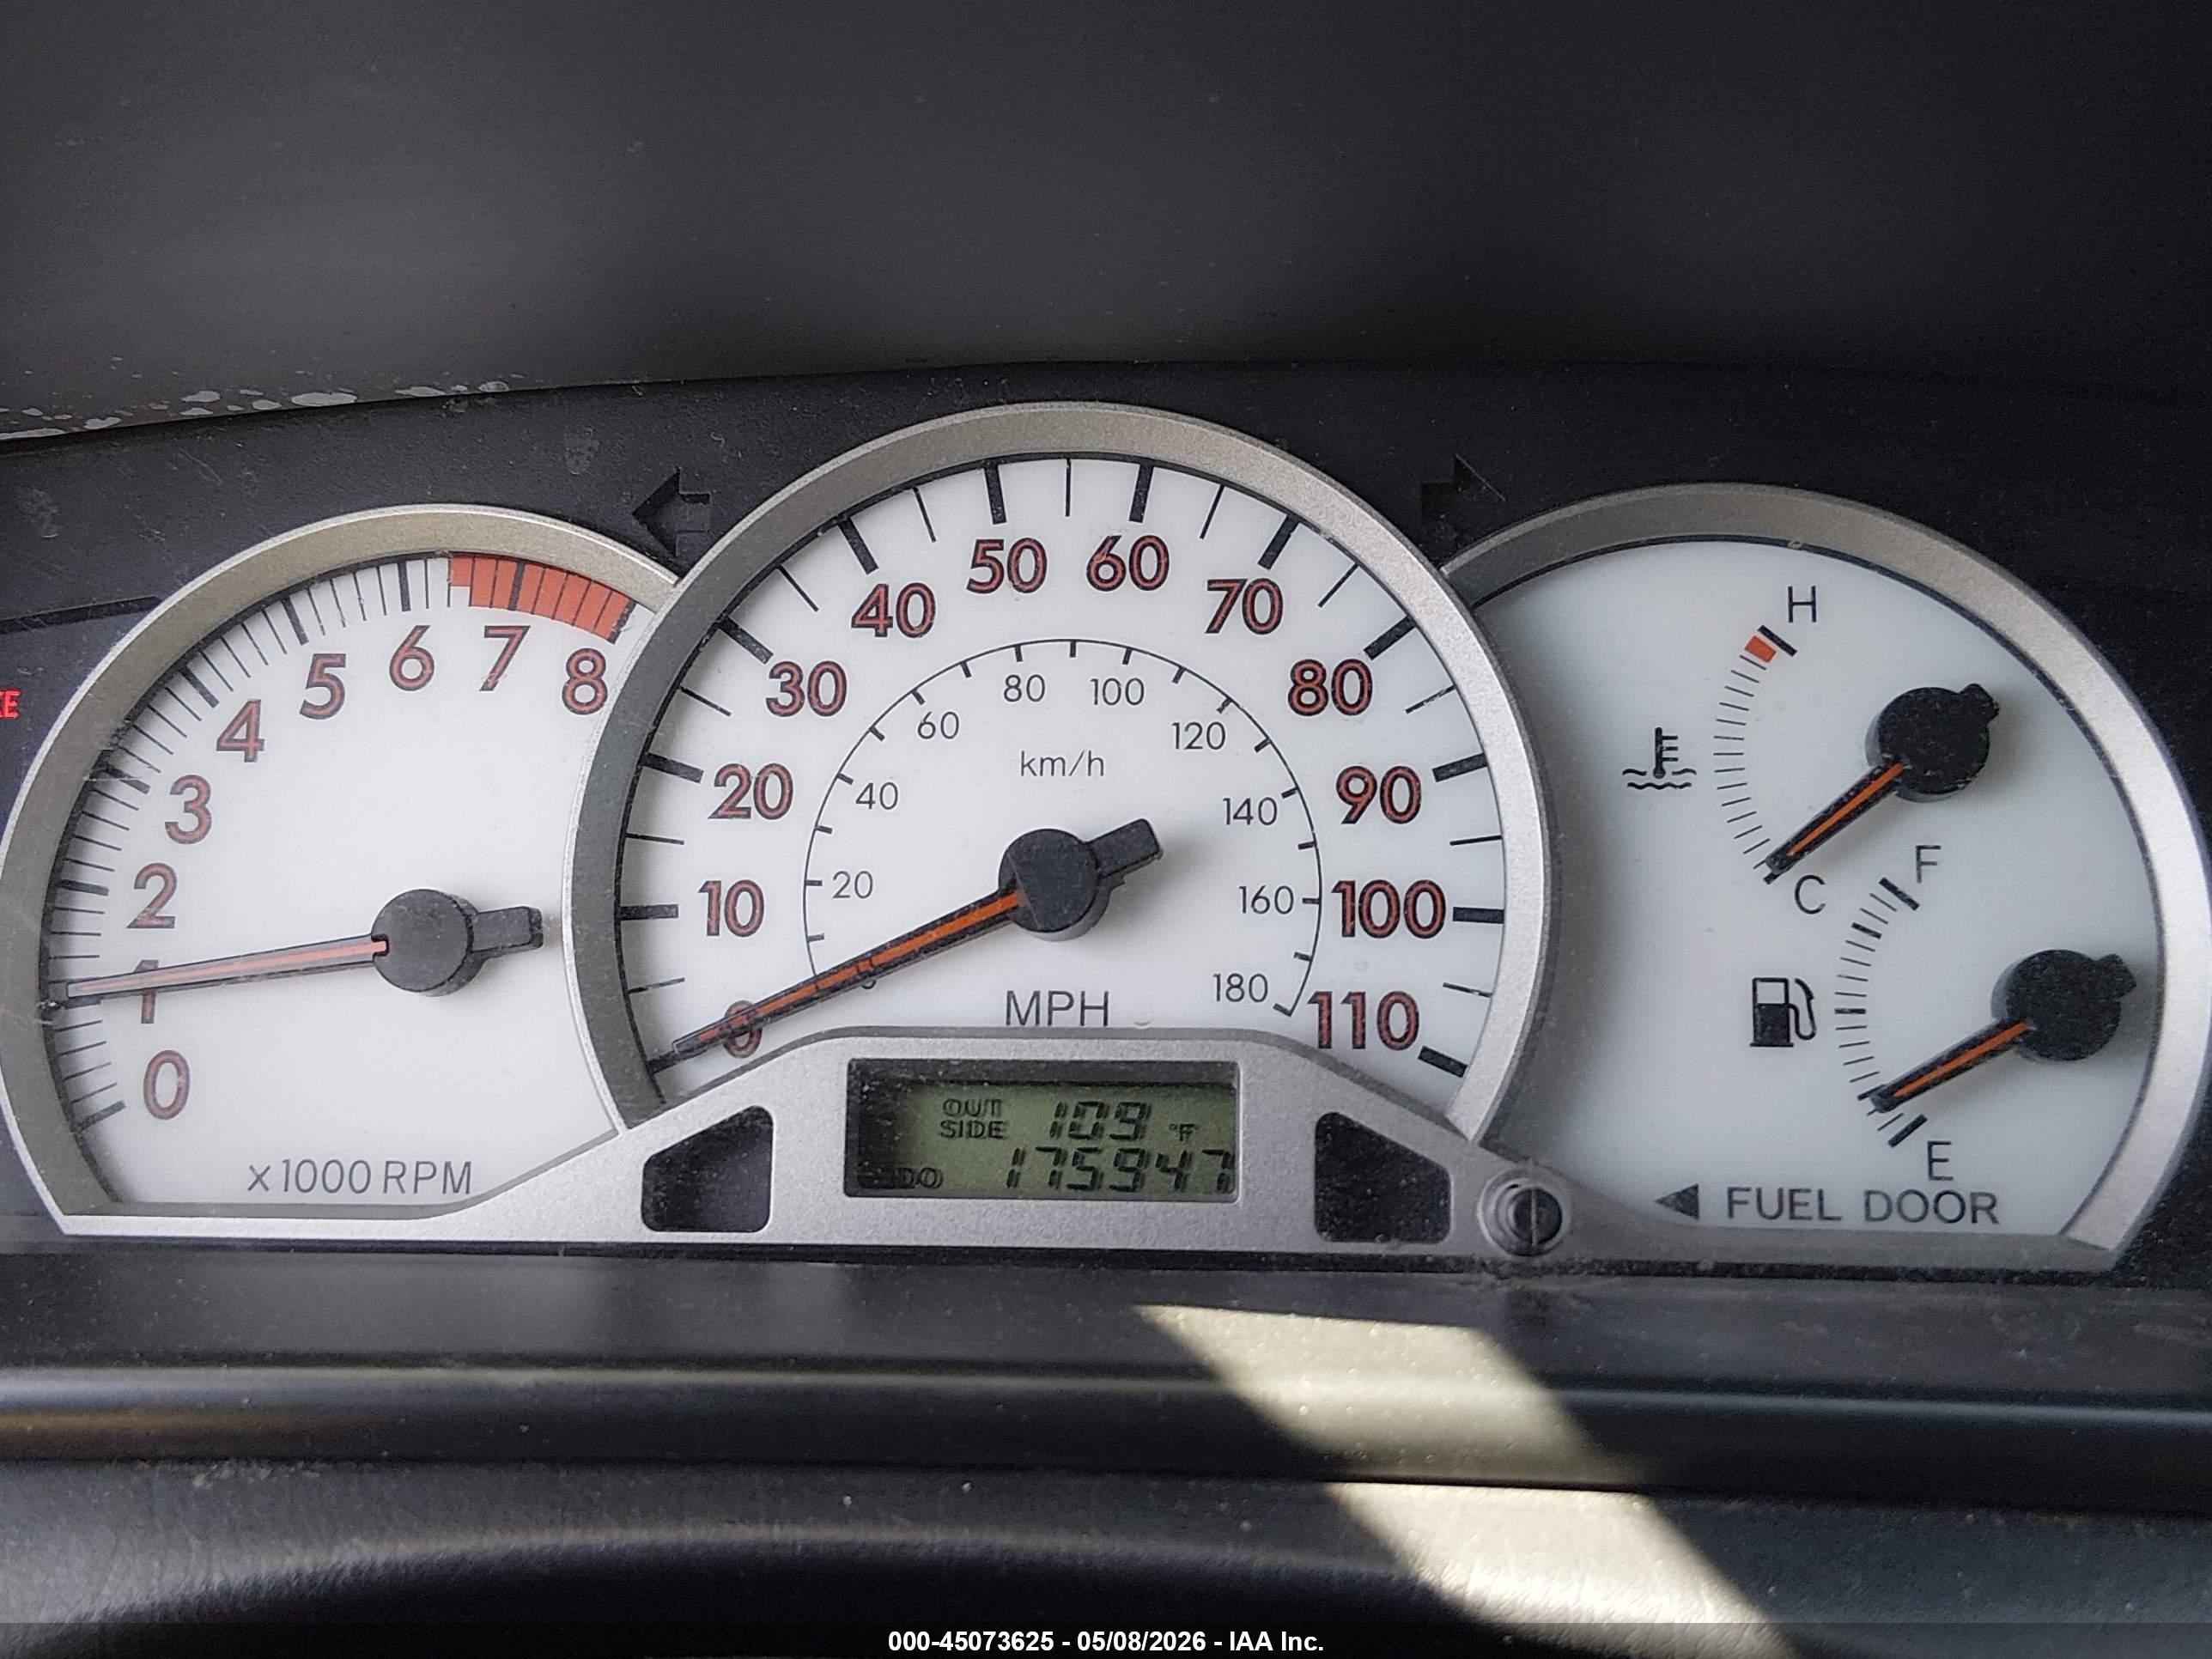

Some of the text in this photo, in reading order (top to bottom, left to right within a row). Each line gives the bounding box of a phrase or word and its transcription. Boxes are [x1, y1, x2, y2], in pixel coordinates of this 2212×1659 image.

[966, 538, 1048, 594] 50
[1086, 535, 1170, 592] 60
[851, 582, 936, 638] 40
[1205, 578, 1283, 635] 70
[1788, 586, 1816, 623] H
[389, 625, 434, 691] 6
[479, 625, 531, 691] 7
[562, 648, 608, 715] 8
[300, 653, 346, 720] 5
[766, 660, 847, 717] 30
[1004, 674, 1045, 702] 80
[1091, 678, 1144, 706] 100
[1288, 659, 1373, 716] 80
[216, 699, 264, 763] 4
[918, 711, 959, 739] 60
[1172, 721, 1225, 750] 120
[1021, 750, 1103, 776] km/h
[165, 775, 211, 844] 3
[708, 763, 793, 820] 20
[855, 782, 898, 810] 40
[1223, 797, 1277, 825] 140
[1336, 766, 1422, 824] 90
[833, 871, 872, 899] 20
[1915, 845, 1941, 884] F
[126, 863, 177, 928] 2
[697, 880, 764, 937] 10
[1239, 885, 1294, 915] 160
[1331, 879, 1446, 939] 100
[1795, 875, 1826, 915] C
[133, 959, 159, 1024] 1
[1006, 991, 1109, 1027] MPH
[1213, 973, 1268, 1003] 180
[722, 1000, 763, 1059] 0
[1308, 992, 1419, 1049] 110
[143, 1050, 190, 1120] 0
[941, 1097, 1003, 1118] OUT
[939, 1119, 1006, 1139] SIDE
[1049, 1101, 1151, 1140] 109
[383, 1160, 472, 1194] RPM
[1006, 1146, 1235, 1193] 175947
[1927, 1140, 1954, 1181] E
[1728, 1188, 1999, 1224] FUEL DOOR
